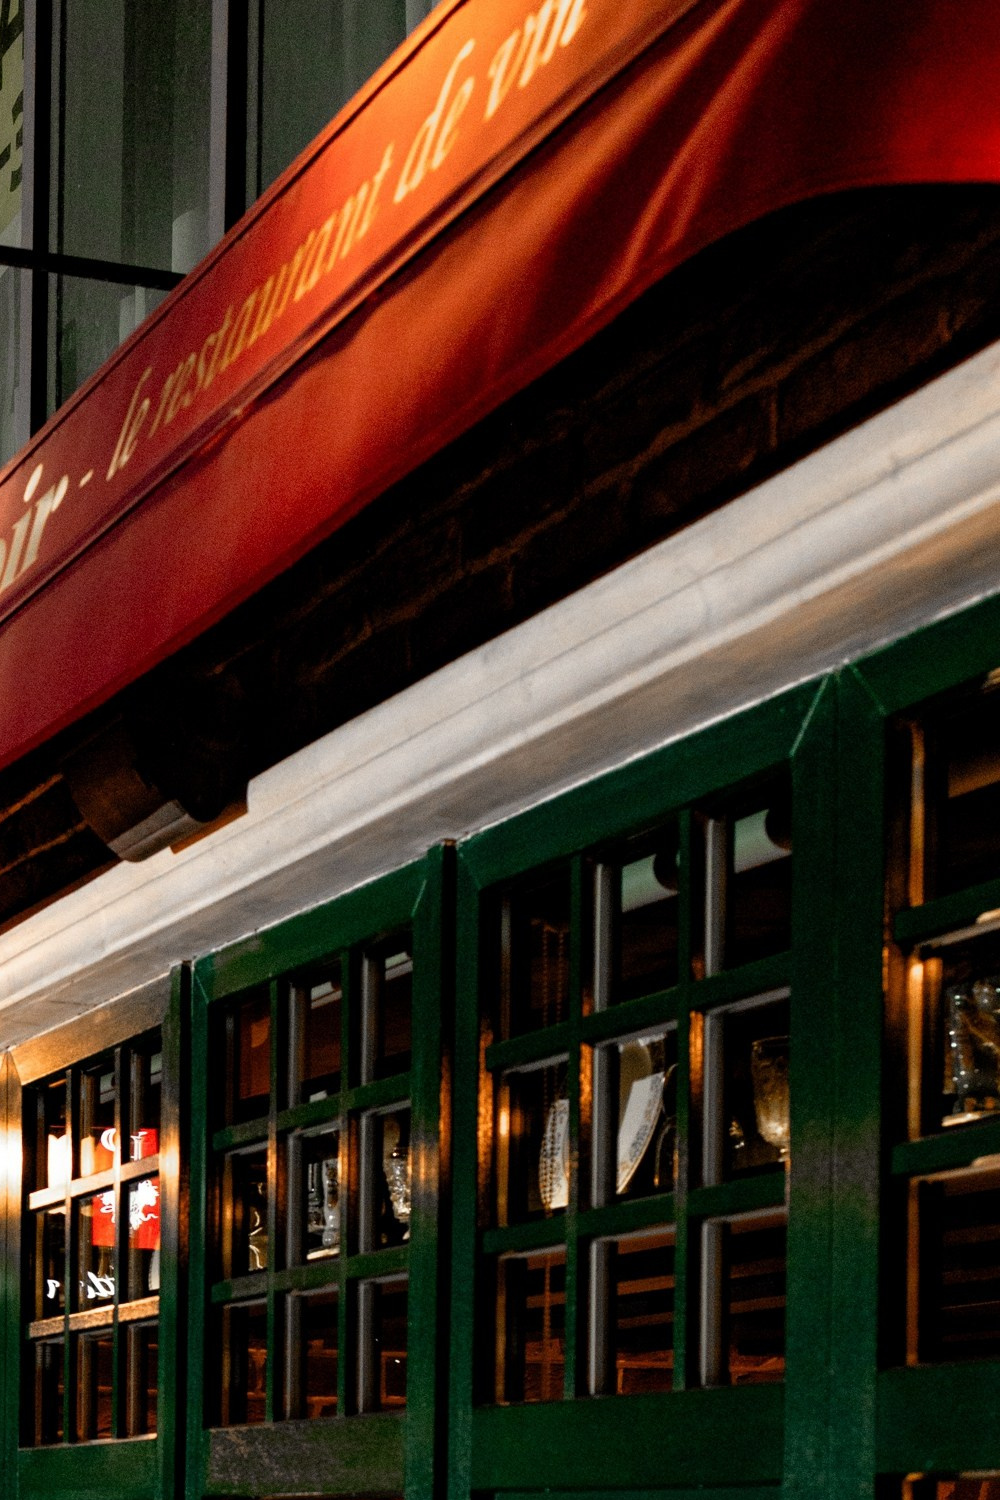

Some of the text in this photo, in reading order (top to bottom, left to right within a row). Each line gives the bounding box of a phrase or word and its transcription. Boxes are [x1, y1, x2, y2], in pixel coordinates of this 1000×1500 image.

[106, 366, 152, 482] le
[149, 143, 395, 437] restaurant
[394, 38, 476, 204] de
